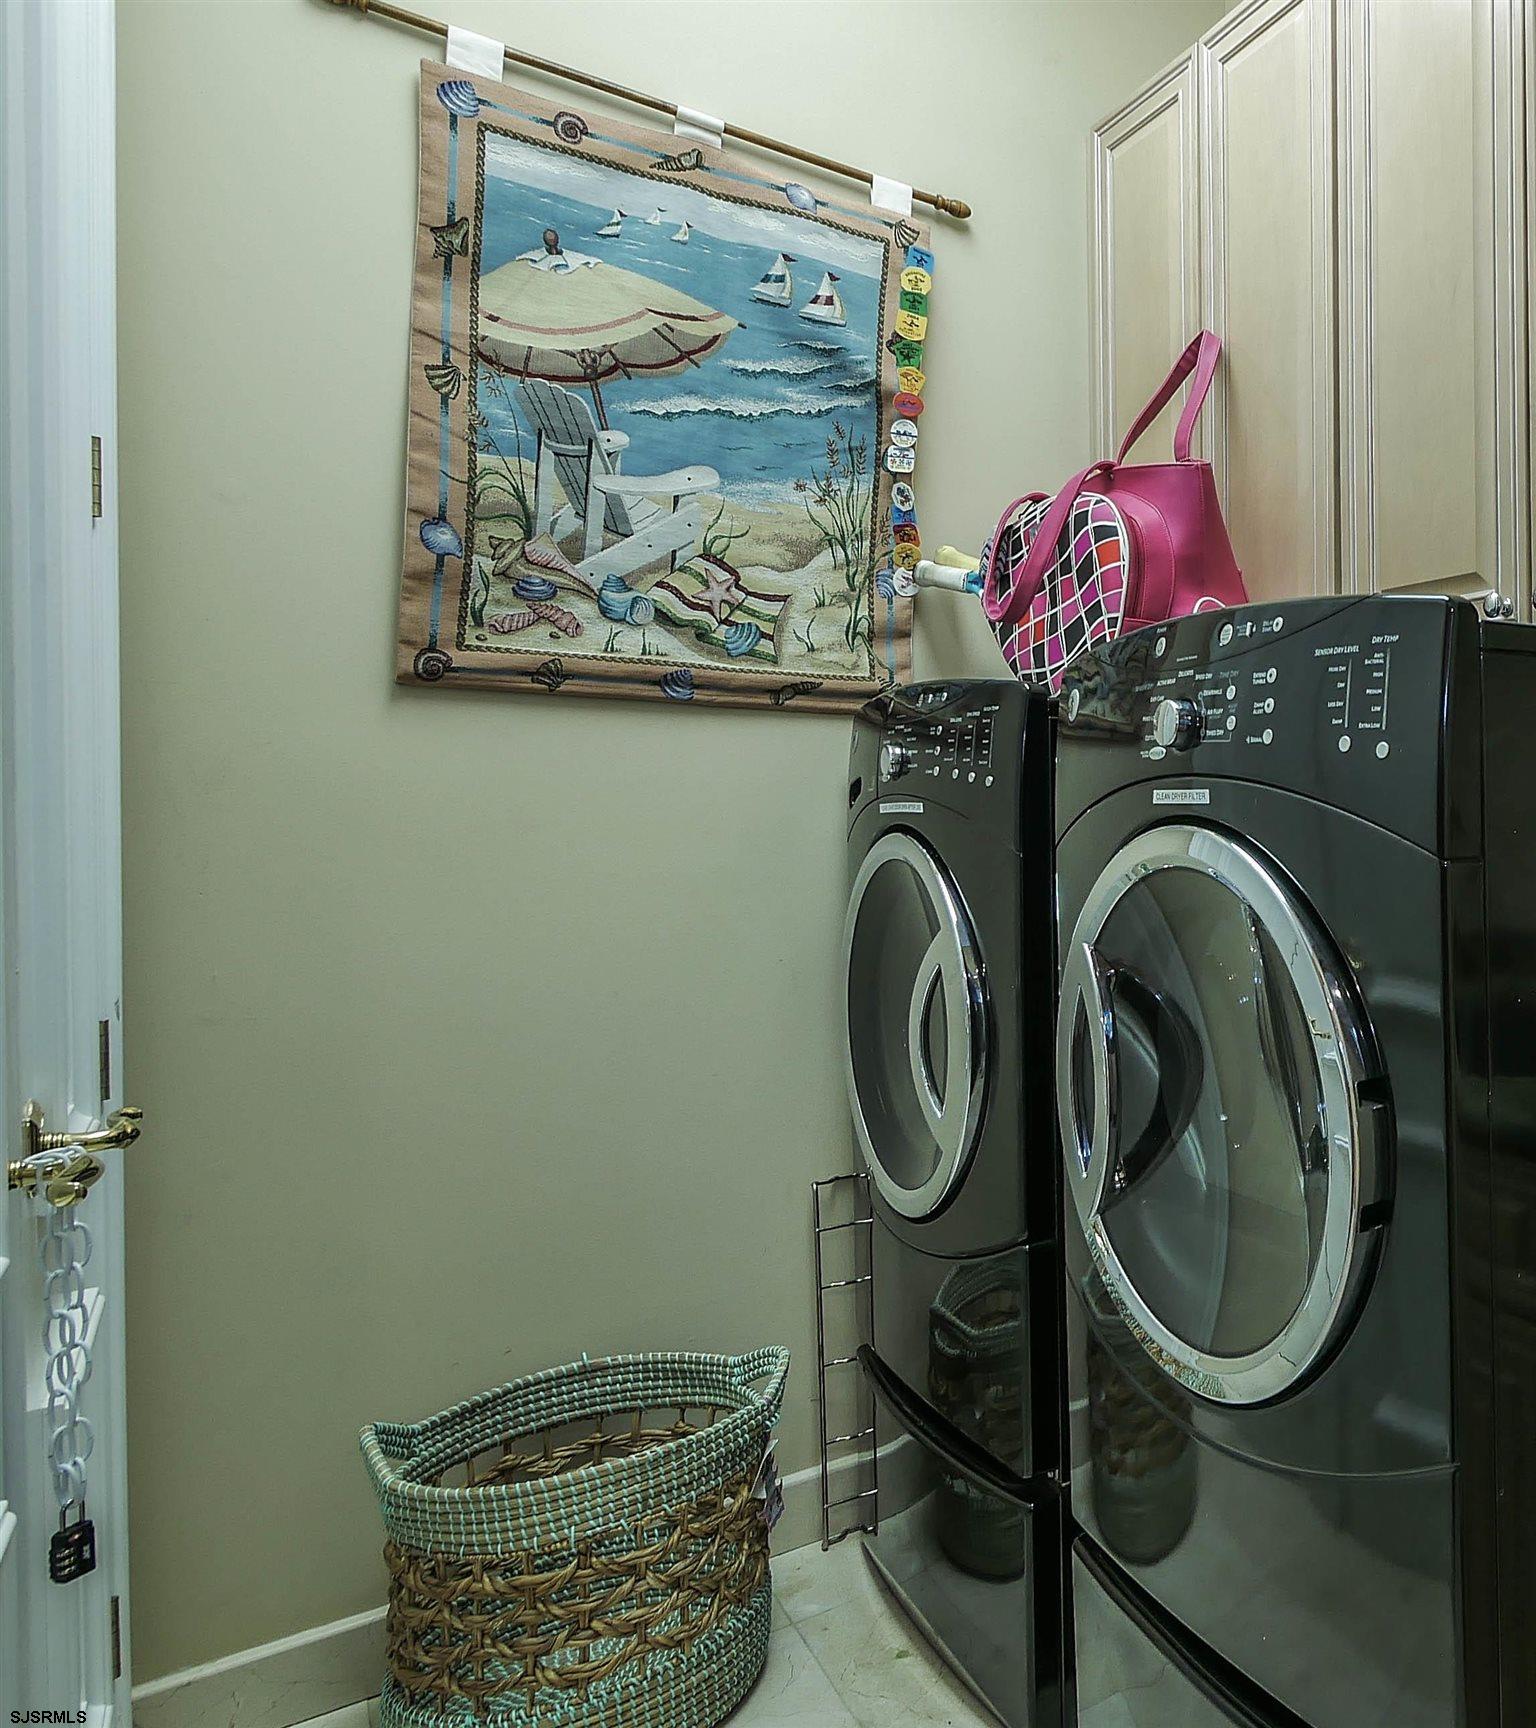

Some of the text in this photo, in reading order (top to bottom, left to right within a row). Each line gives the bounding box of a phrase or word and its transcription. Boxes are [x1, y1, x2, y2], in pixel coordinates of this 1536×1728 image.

[1372, 636, 1384, 644] DRY
[1314, 648, 1333, 656] SENSOR
[1345, 645, 1359, 653] LEVEL
[1156, 792, 1206, 800] CLEAN DRYER FILTER
